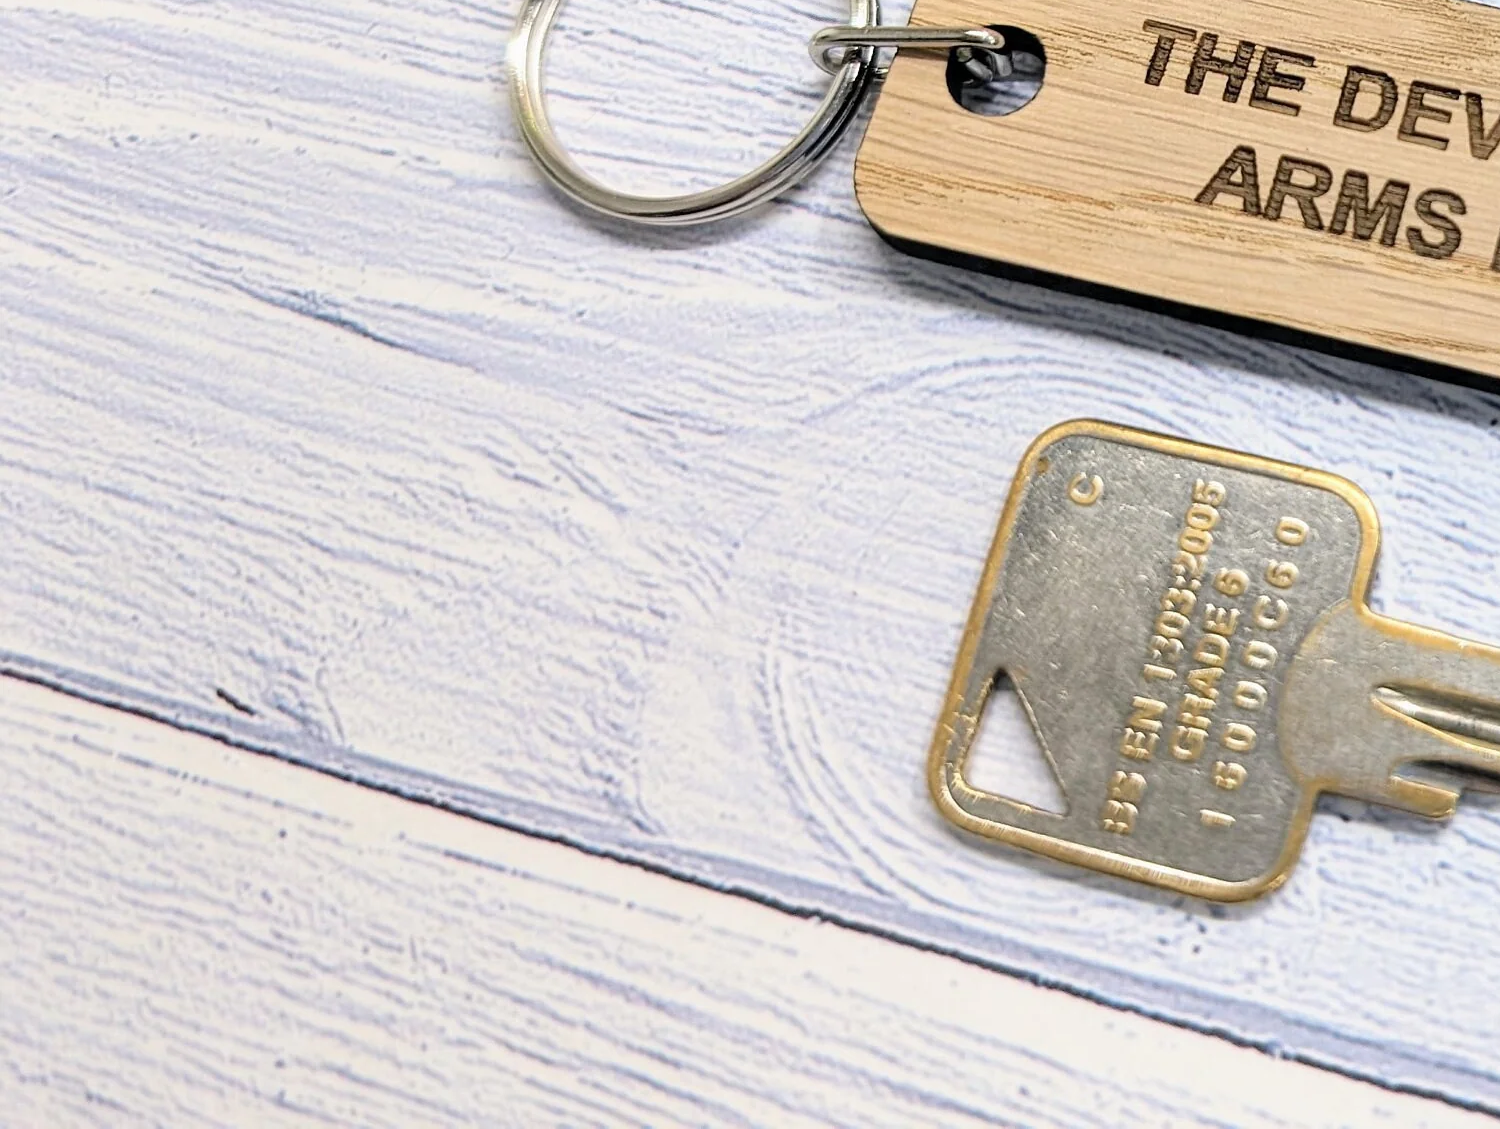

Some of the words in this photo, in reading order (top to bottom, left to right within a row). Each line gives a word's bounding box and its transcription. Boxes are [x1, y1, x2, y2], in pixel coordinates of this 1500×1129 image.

[1139, 21, 1316, 116] THE
[1196, 145, 1467, 259] ARMS
[1170, 603, 1241, 761] GRADE
[1219, 569, 1249, 596] 6
[1120, 695, 1168, 761] EN
